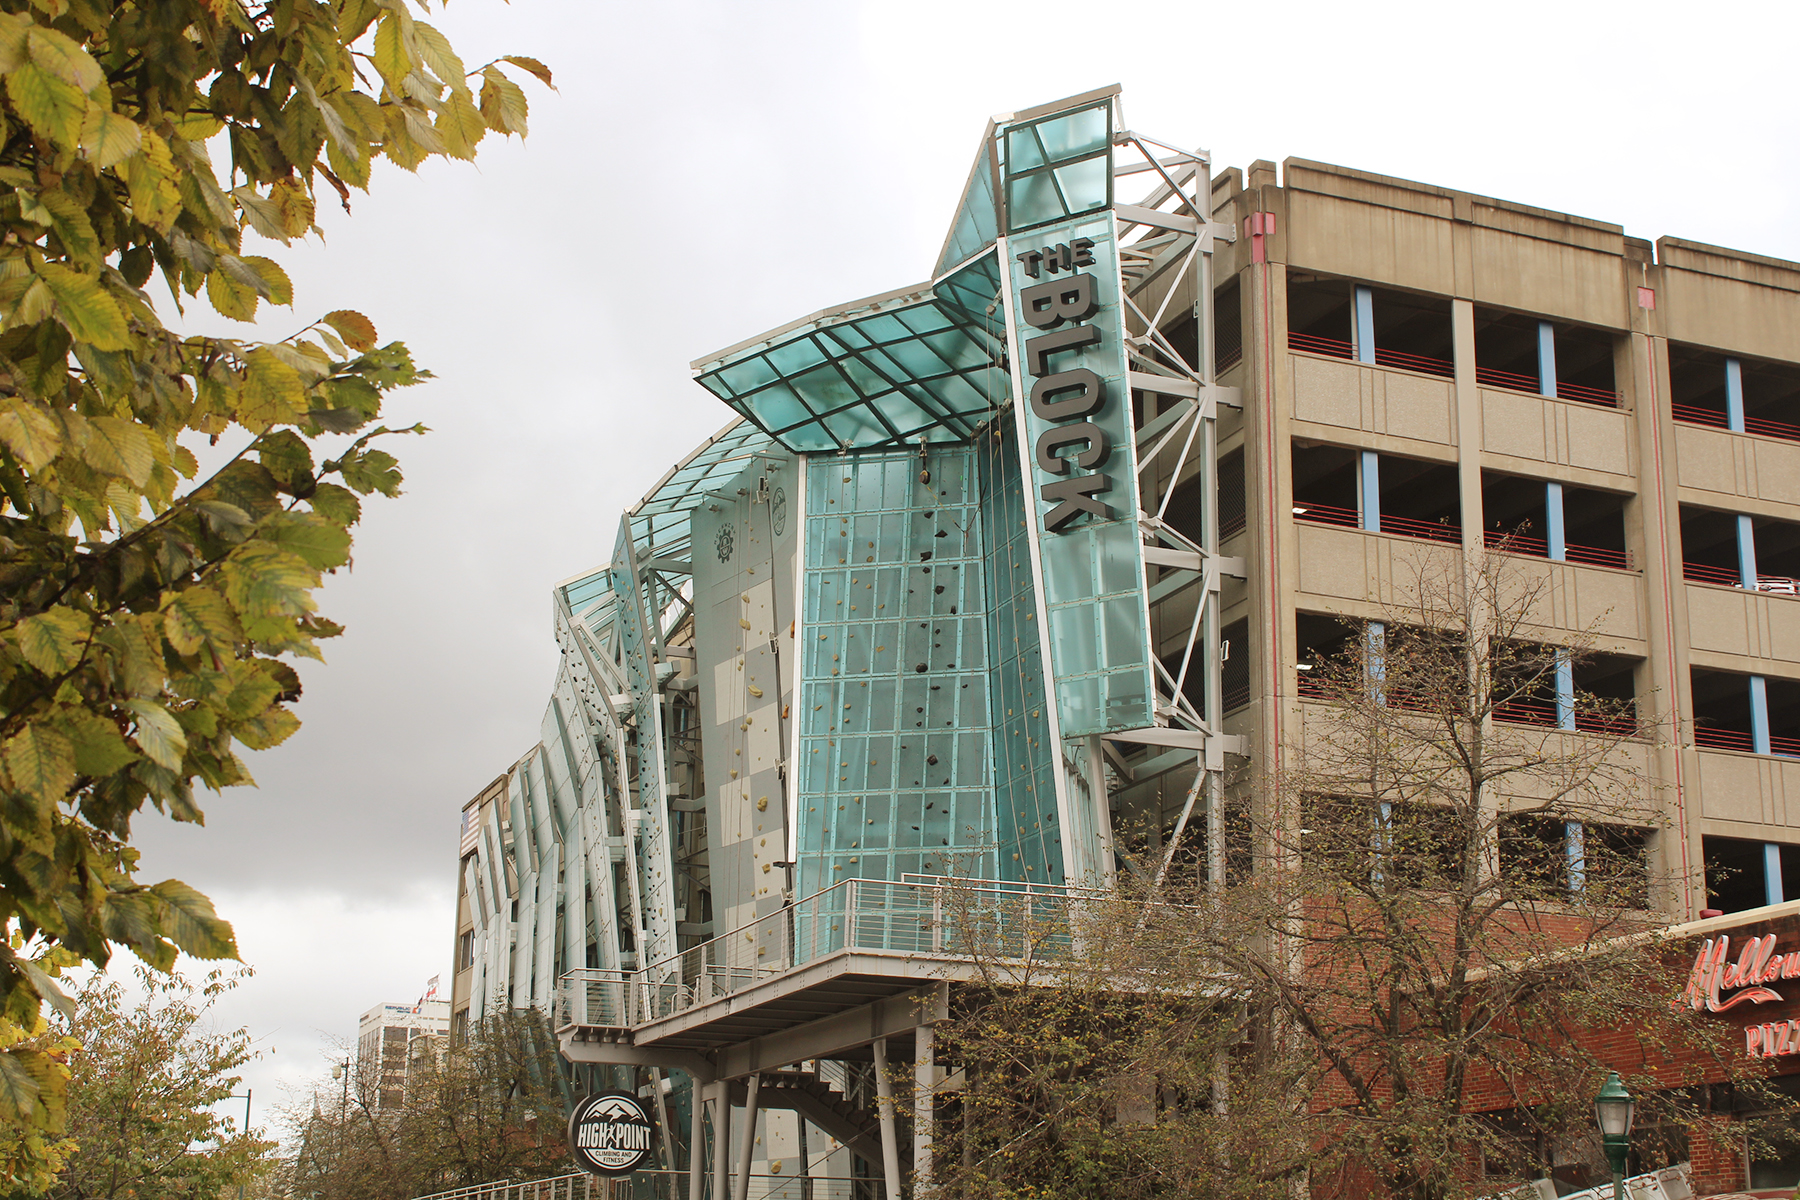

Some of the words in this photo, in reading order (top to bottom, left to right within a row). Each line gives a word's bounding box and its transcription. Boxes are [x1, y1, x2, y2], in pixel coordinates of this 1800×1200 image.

[1017, 237, 1096, 279] THE
[1020, 272, 1115, 534] BLOCK
[577, 1122, 608, 1148] HIGH
[615, 1122, 651, 1150] POINT
[603, 1156, 624, 1164] FITNESS
